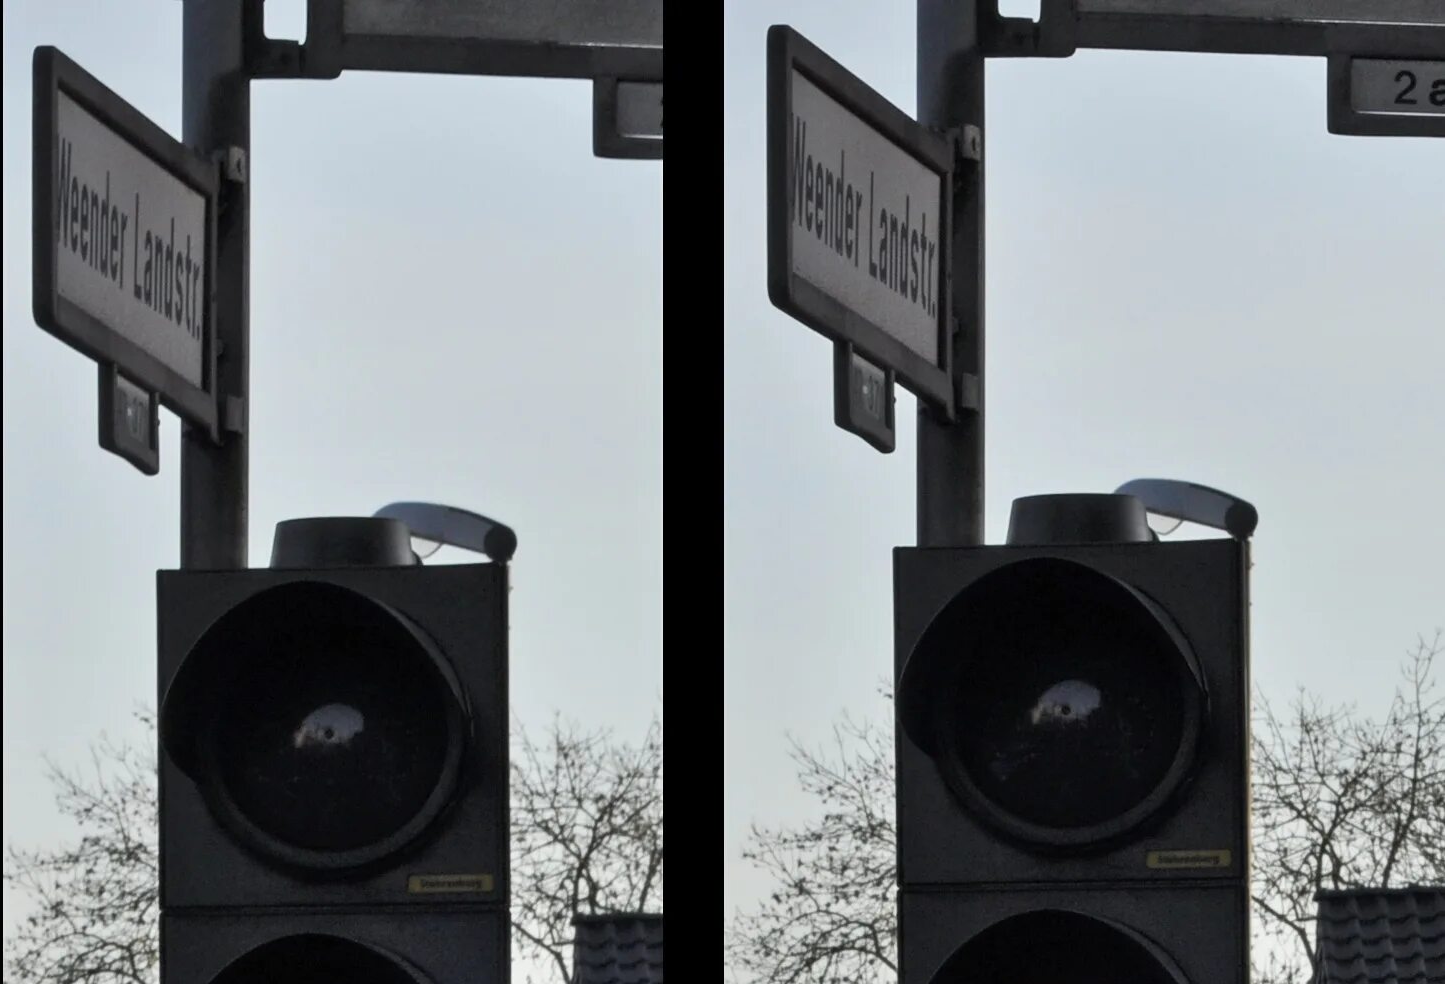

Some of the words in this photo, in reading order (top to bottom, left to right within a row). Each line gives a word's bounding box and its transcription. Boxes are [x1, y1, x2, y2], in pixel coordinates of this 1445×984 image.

[1394, 70, 1417, 105] 2
[57, 133, 128, 289] Weender
[134, 192, 201, 340] Landstr.
[791, 113, 863, 268] Weender
[869, 171, 936, 319] Landstr.
